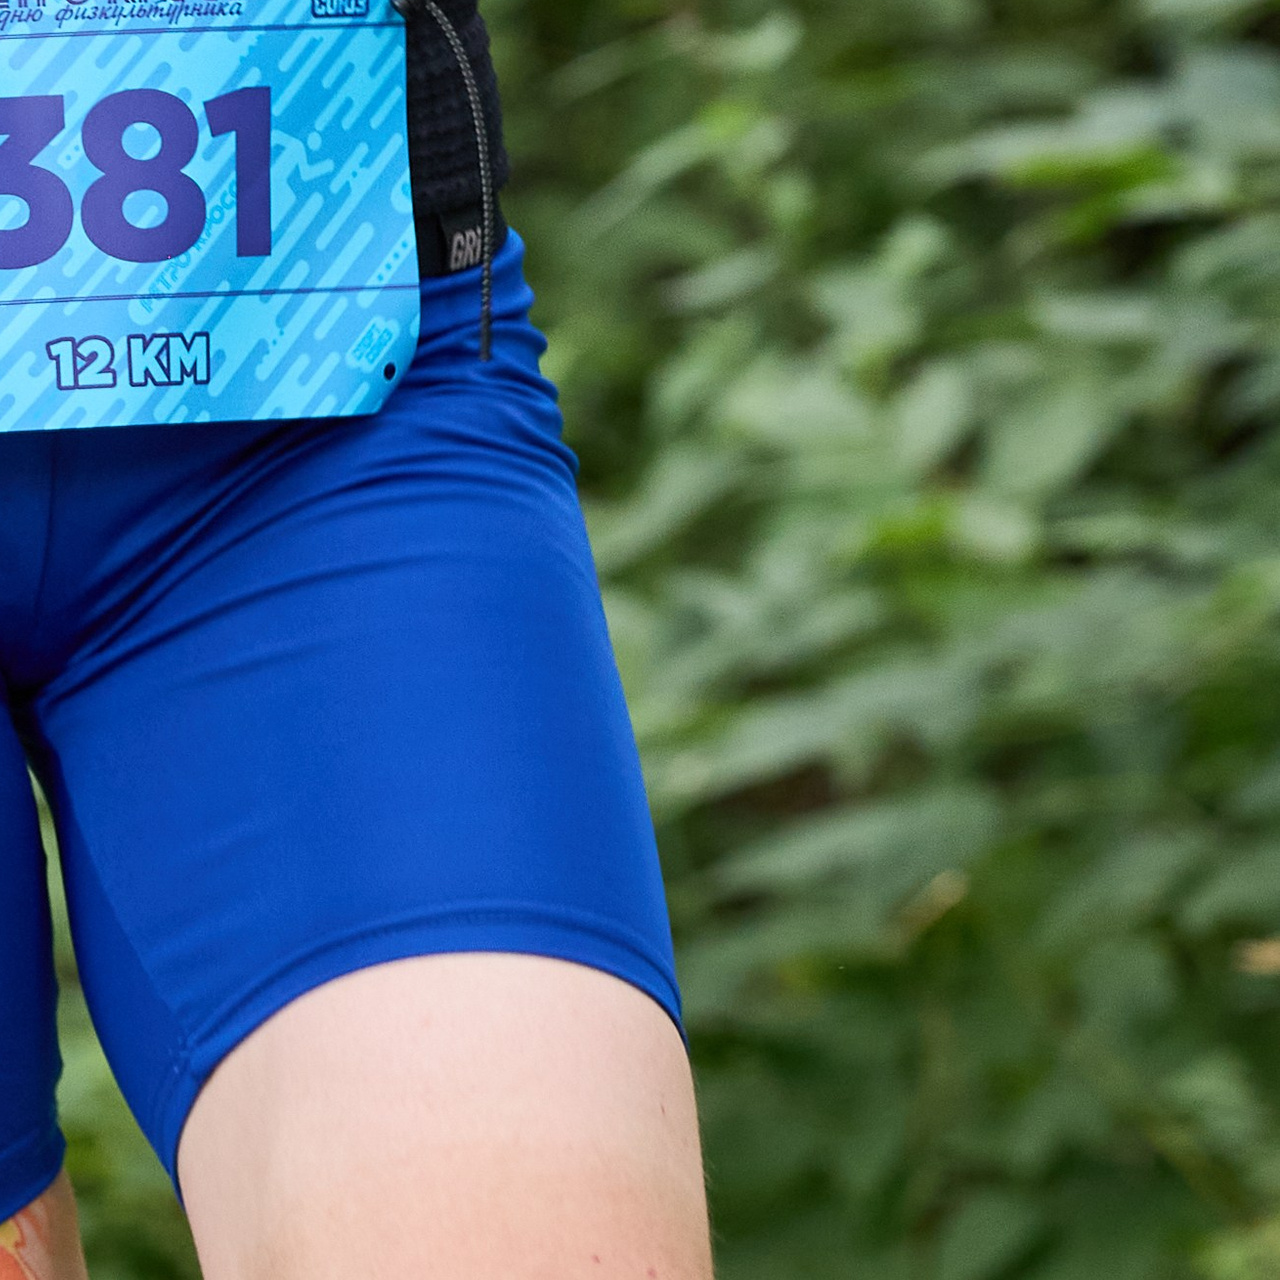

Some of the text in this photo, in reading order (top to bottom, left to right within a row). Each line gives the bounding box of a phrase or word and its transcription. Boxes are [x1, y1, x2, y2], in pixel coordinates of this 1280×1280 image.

[55, 0, 244, 28] физкультурника
[46, 331, 211, 390] 12 КМ
